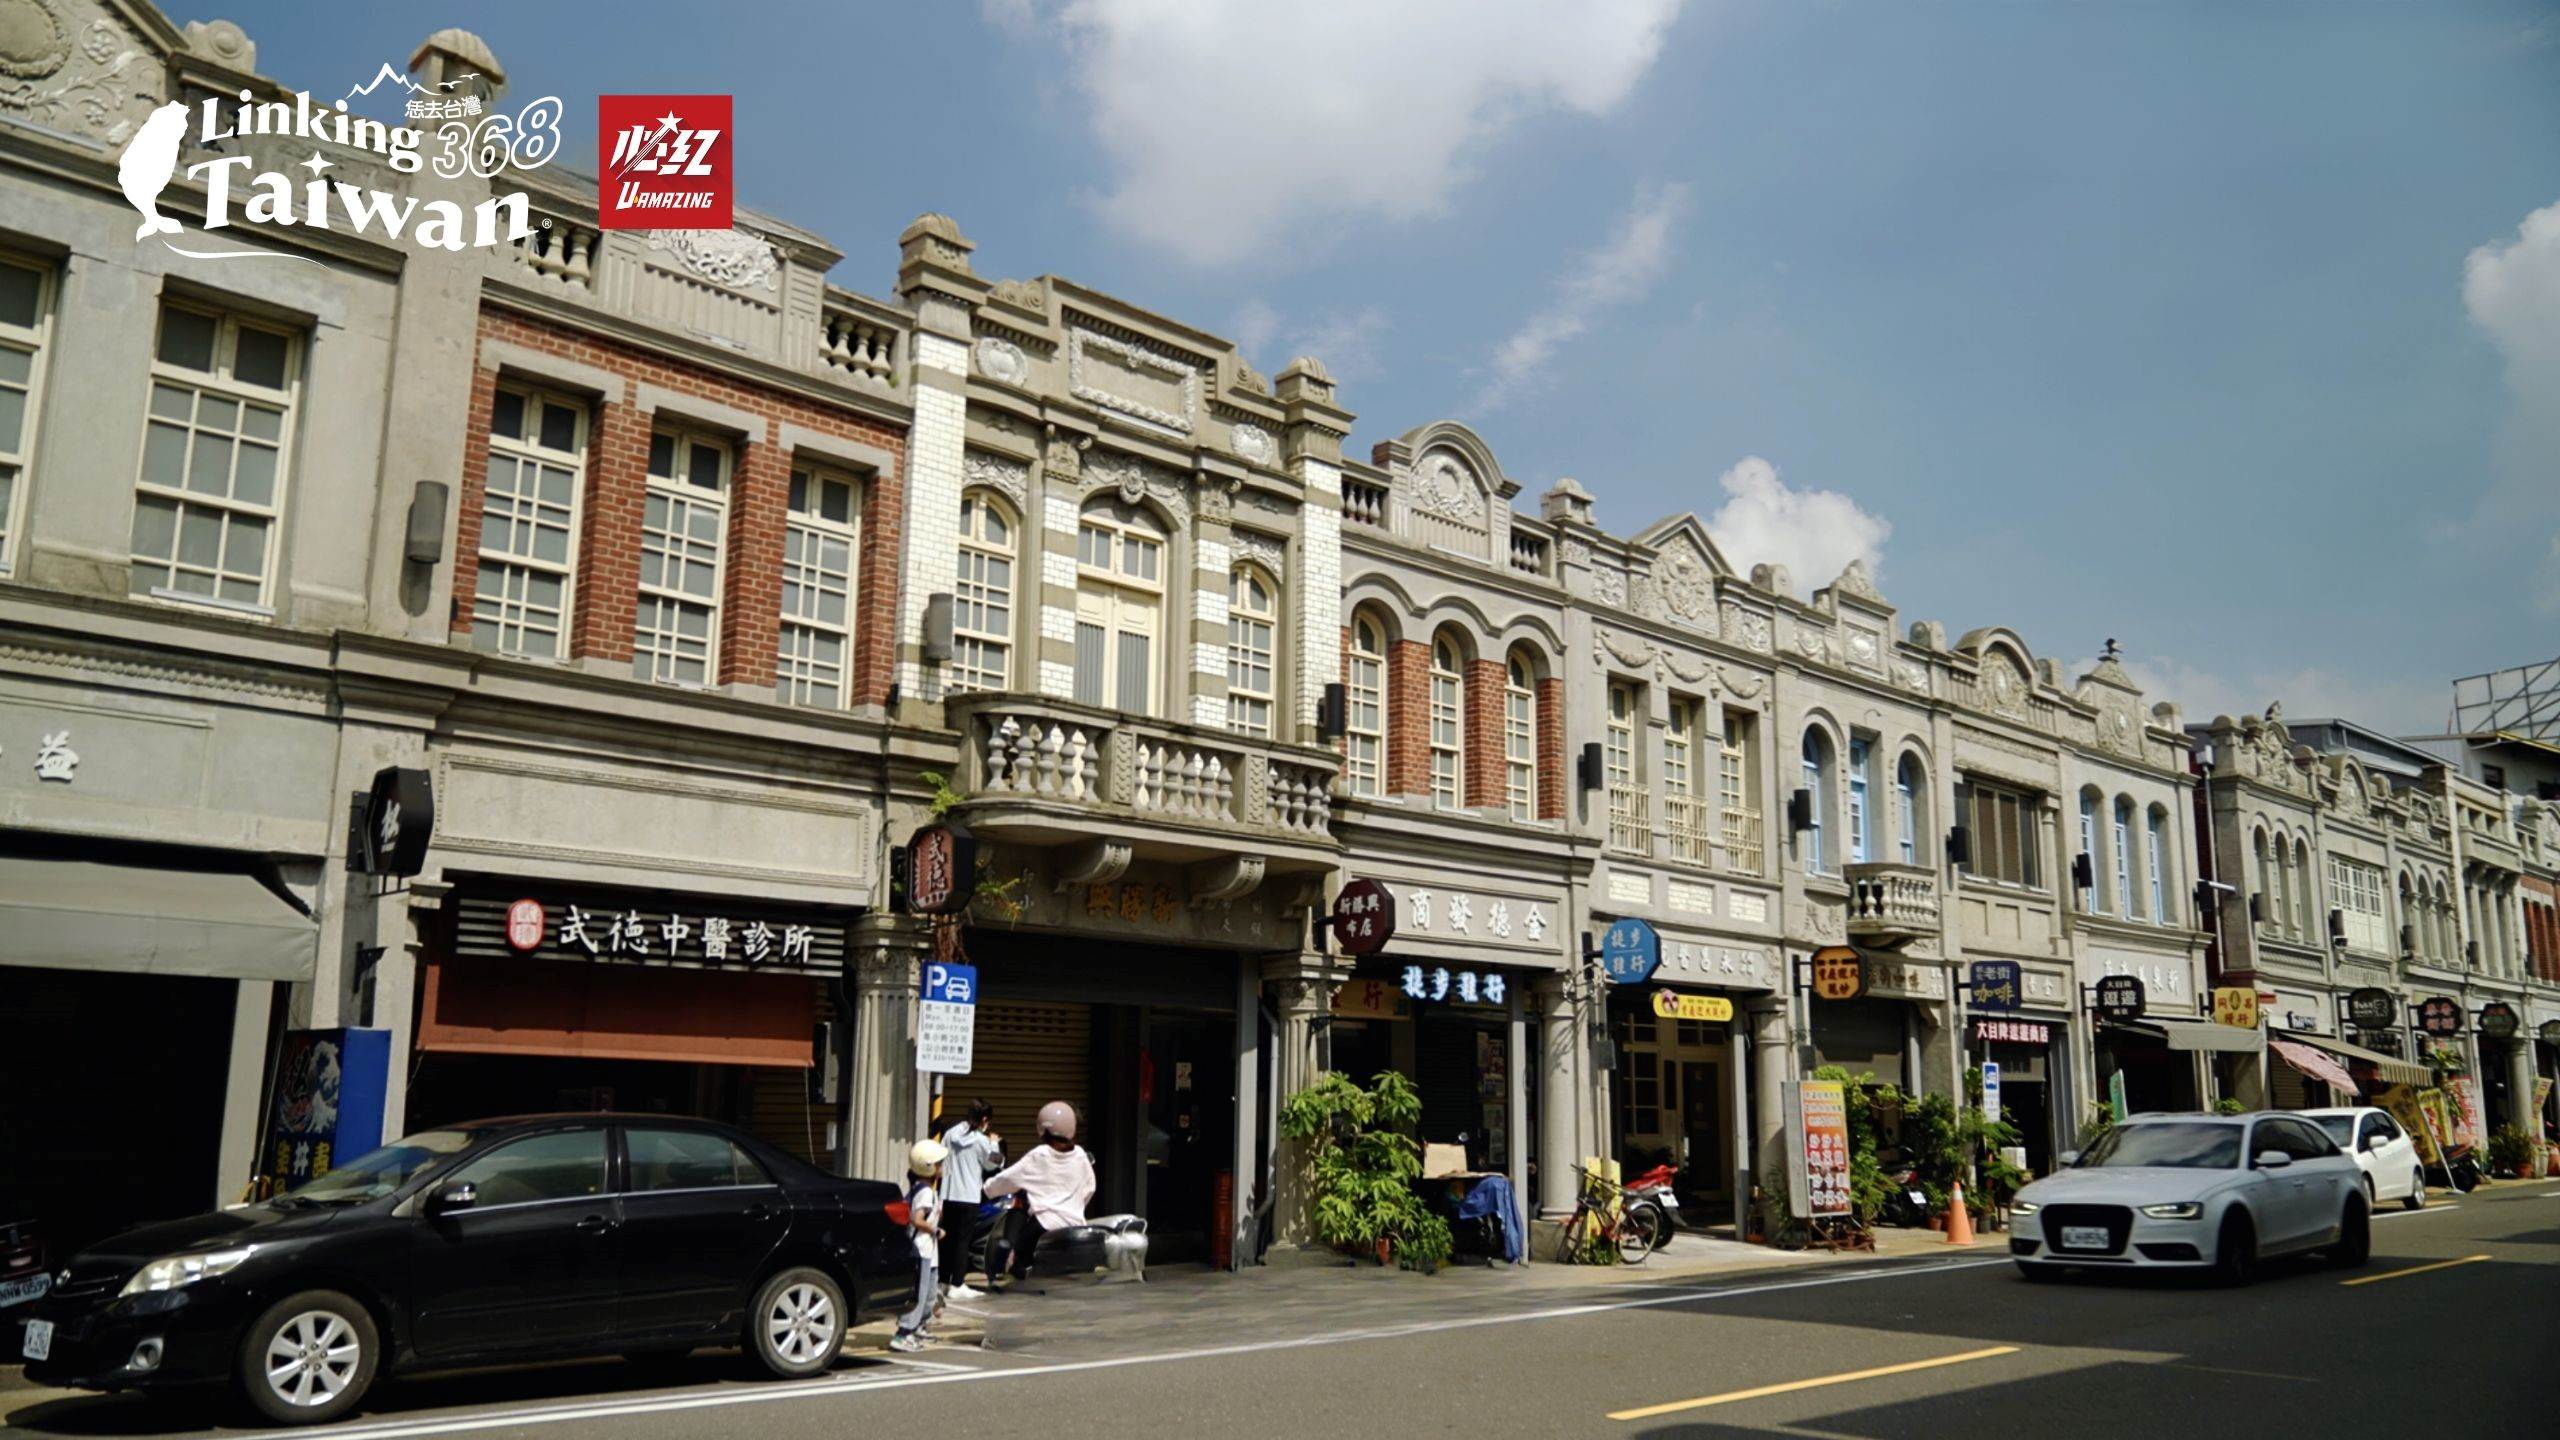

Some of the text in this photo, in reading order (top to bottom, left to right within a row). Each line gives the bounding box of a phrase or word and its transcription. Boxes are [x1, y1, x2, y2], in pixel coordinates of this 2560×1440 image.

[559, 904, 815, 963] 武德中醫診所
[1612, 954, 1647, 975] 鞋行
[925, 965, 947, 998] P
[1973, 981, 2015, 1005] 咖啡
